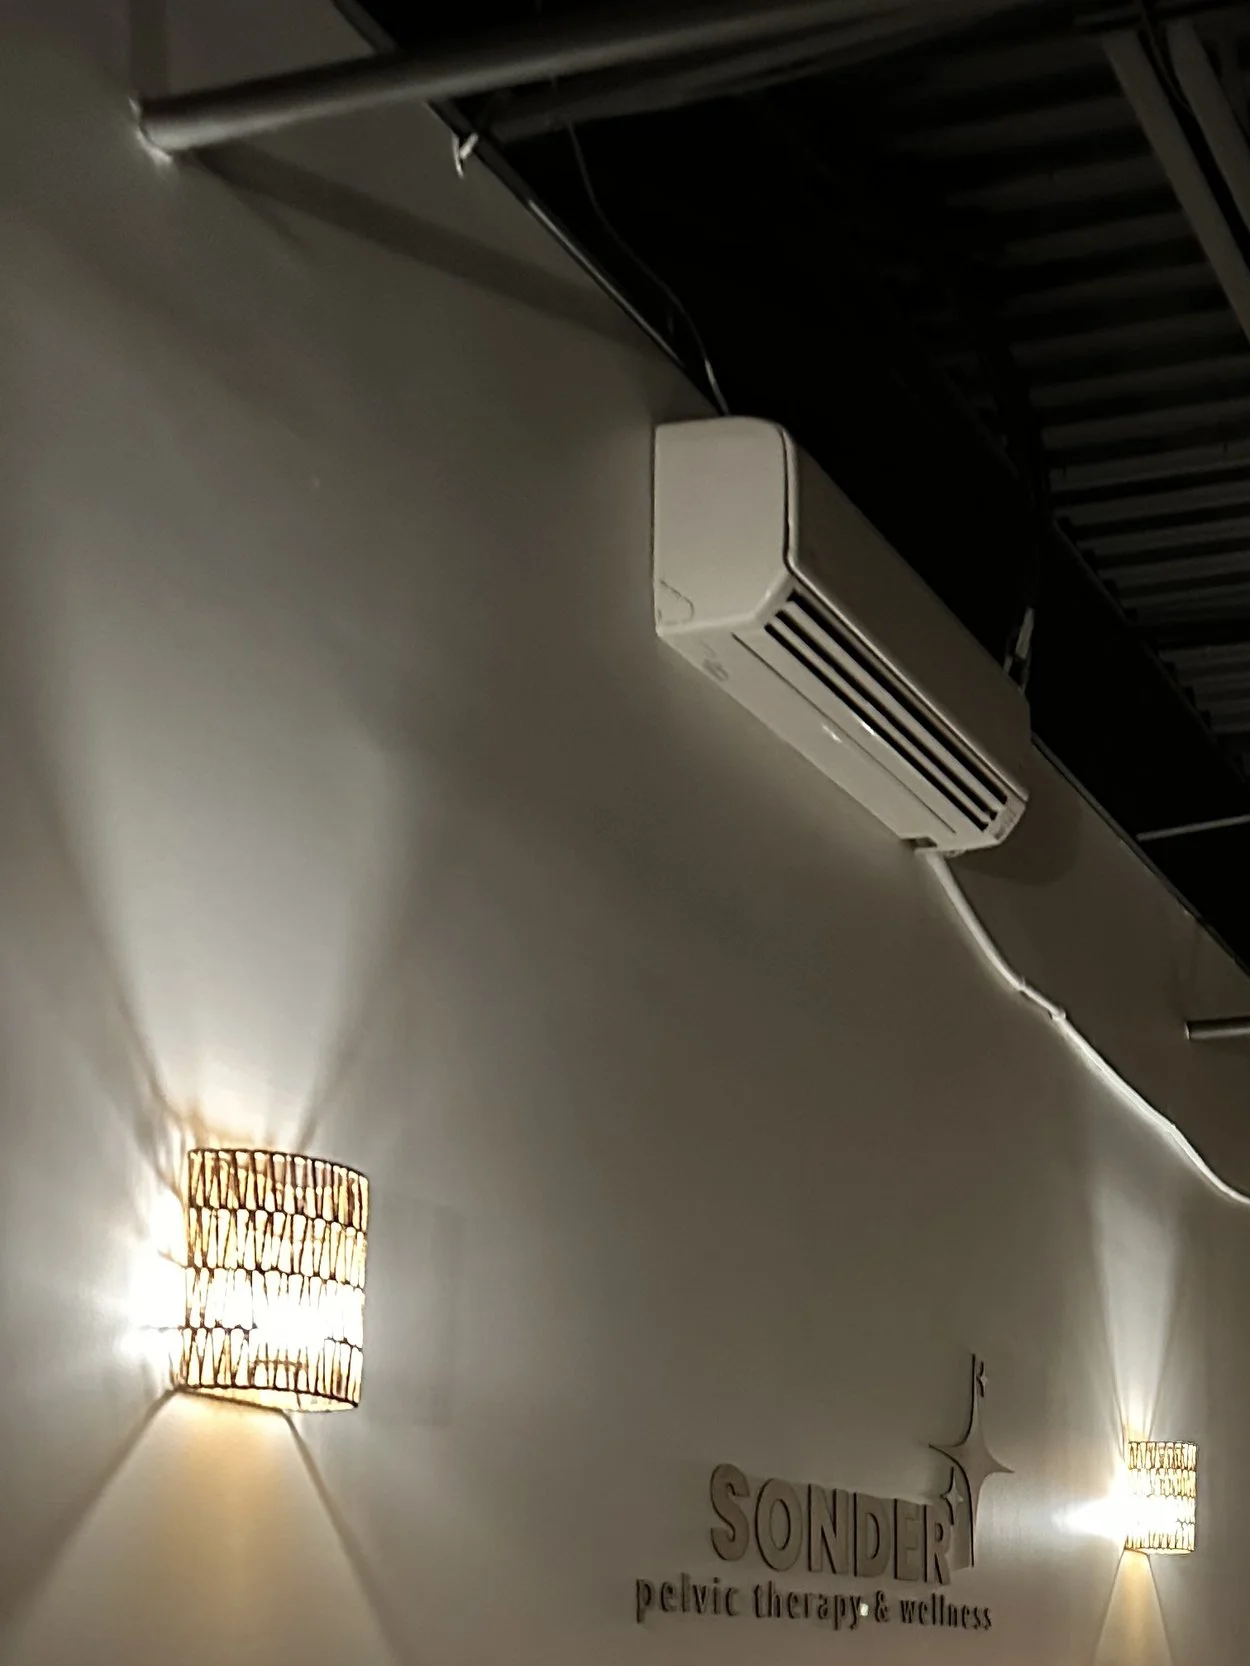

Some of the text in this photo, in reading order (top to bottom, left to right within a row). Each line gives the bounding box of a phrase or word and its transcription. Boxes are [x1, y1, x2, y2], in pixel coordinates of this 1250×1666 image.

[711, 1464, 950, 1585] SONDER
[635, 1572, 993, 1631] pelvic therapy & wellness
